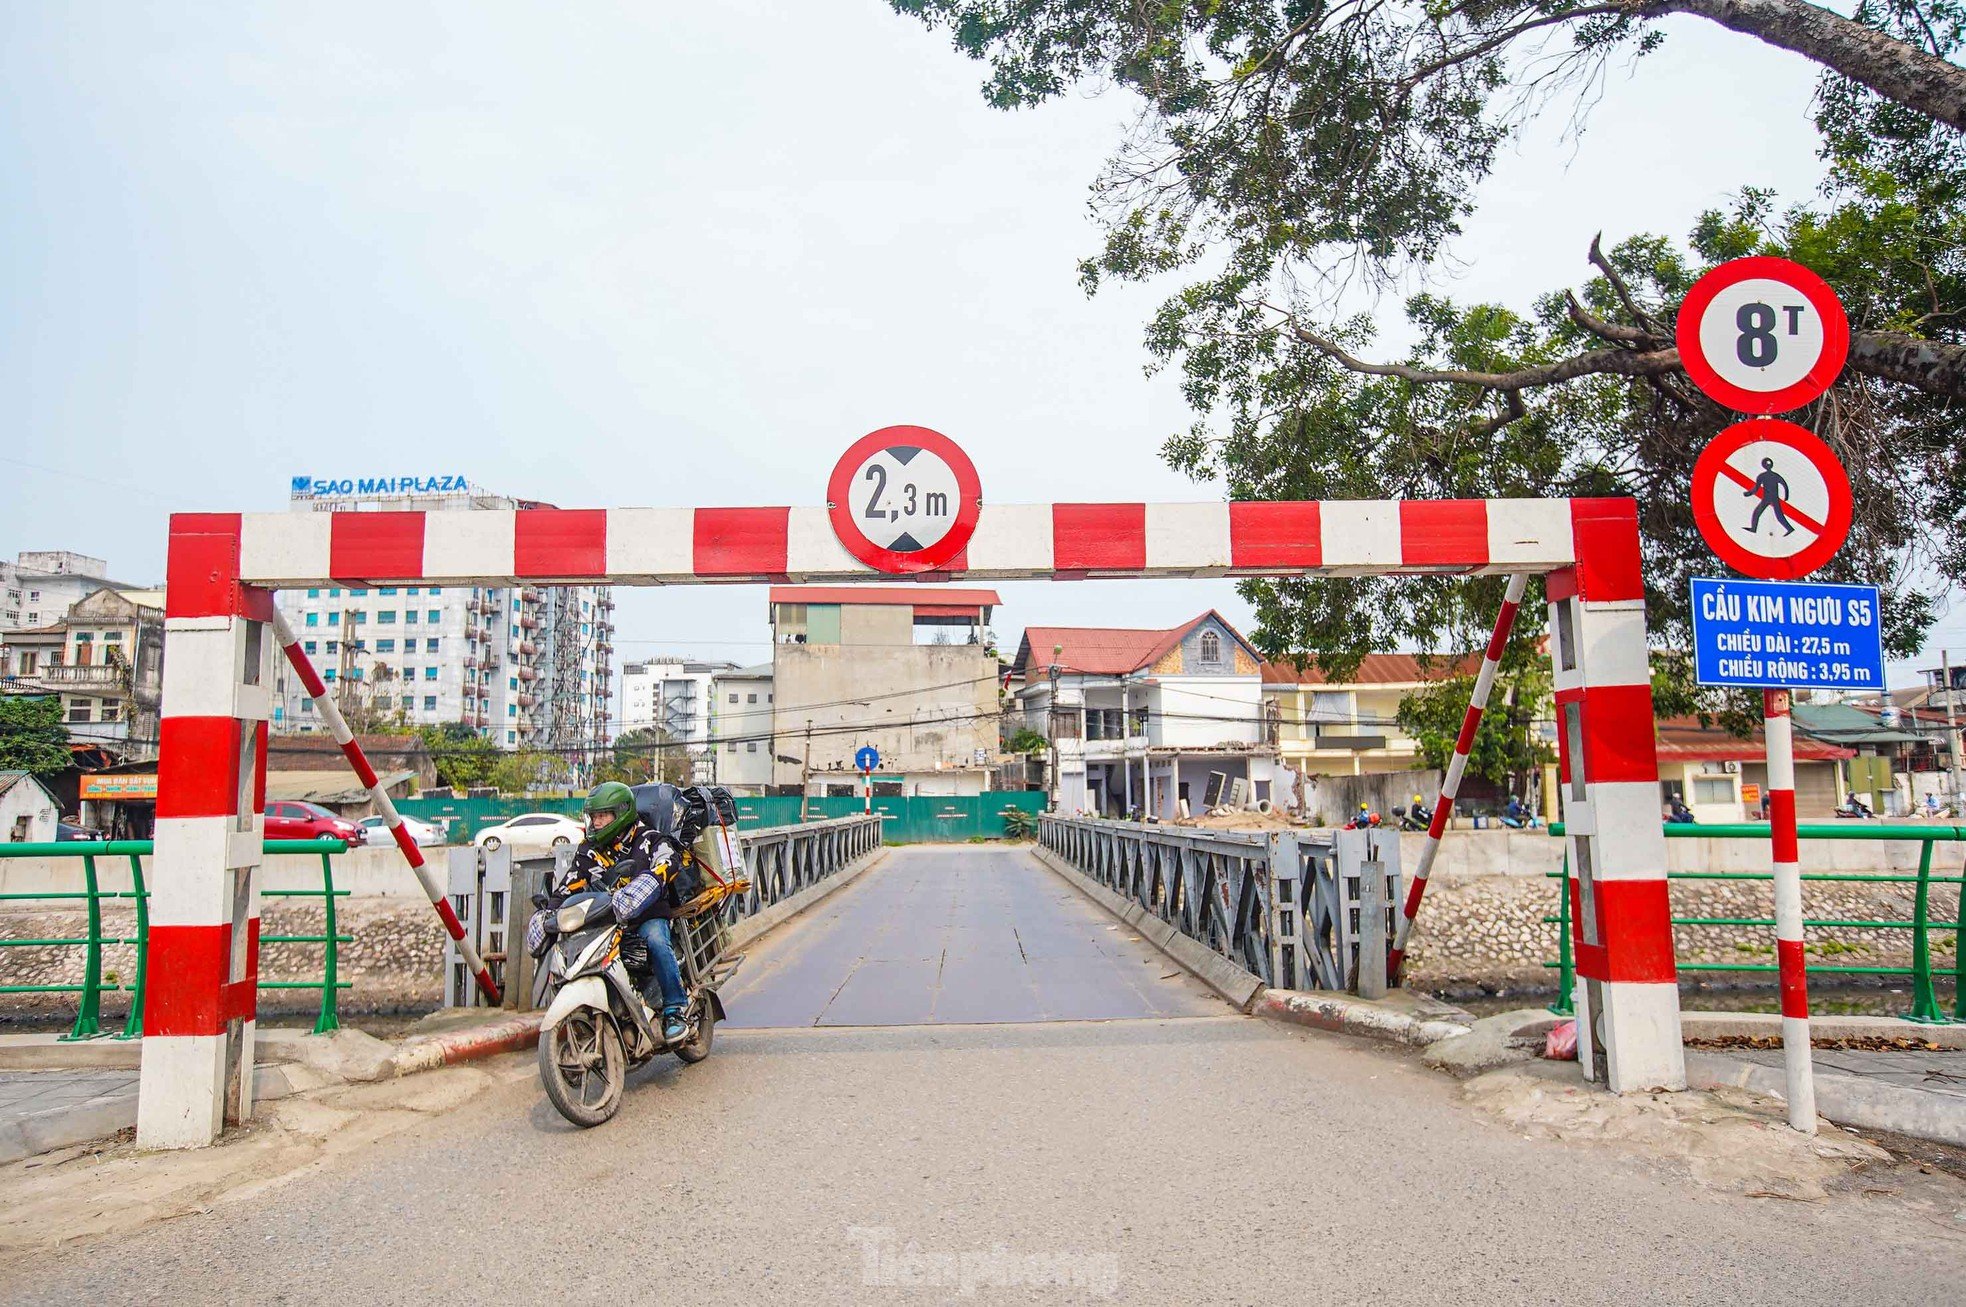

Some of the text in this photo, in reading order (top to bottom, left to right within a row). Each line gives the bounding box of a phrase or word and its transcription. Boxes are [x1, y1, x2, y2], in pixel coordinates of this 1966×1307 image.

[313, 475, 468, 494] SAO MAI PLAZA
[1702, 585, 1872, 627] CẦU KIM NGƯU S5
[1717, 628, 1761, 652] CHIỀU
[1766, 632, 1790, 653] DÀI
[1802, 636, 1831, 656] 27,5
[1834, 642, 1851, 655] m
[1719, 654, 1763, 678] CHIỀU
[1767, 658, 1808, 683] RỘNG
[1820, 662, 1850, 681] 3,95
[1854, 668, 1871, 681] m
